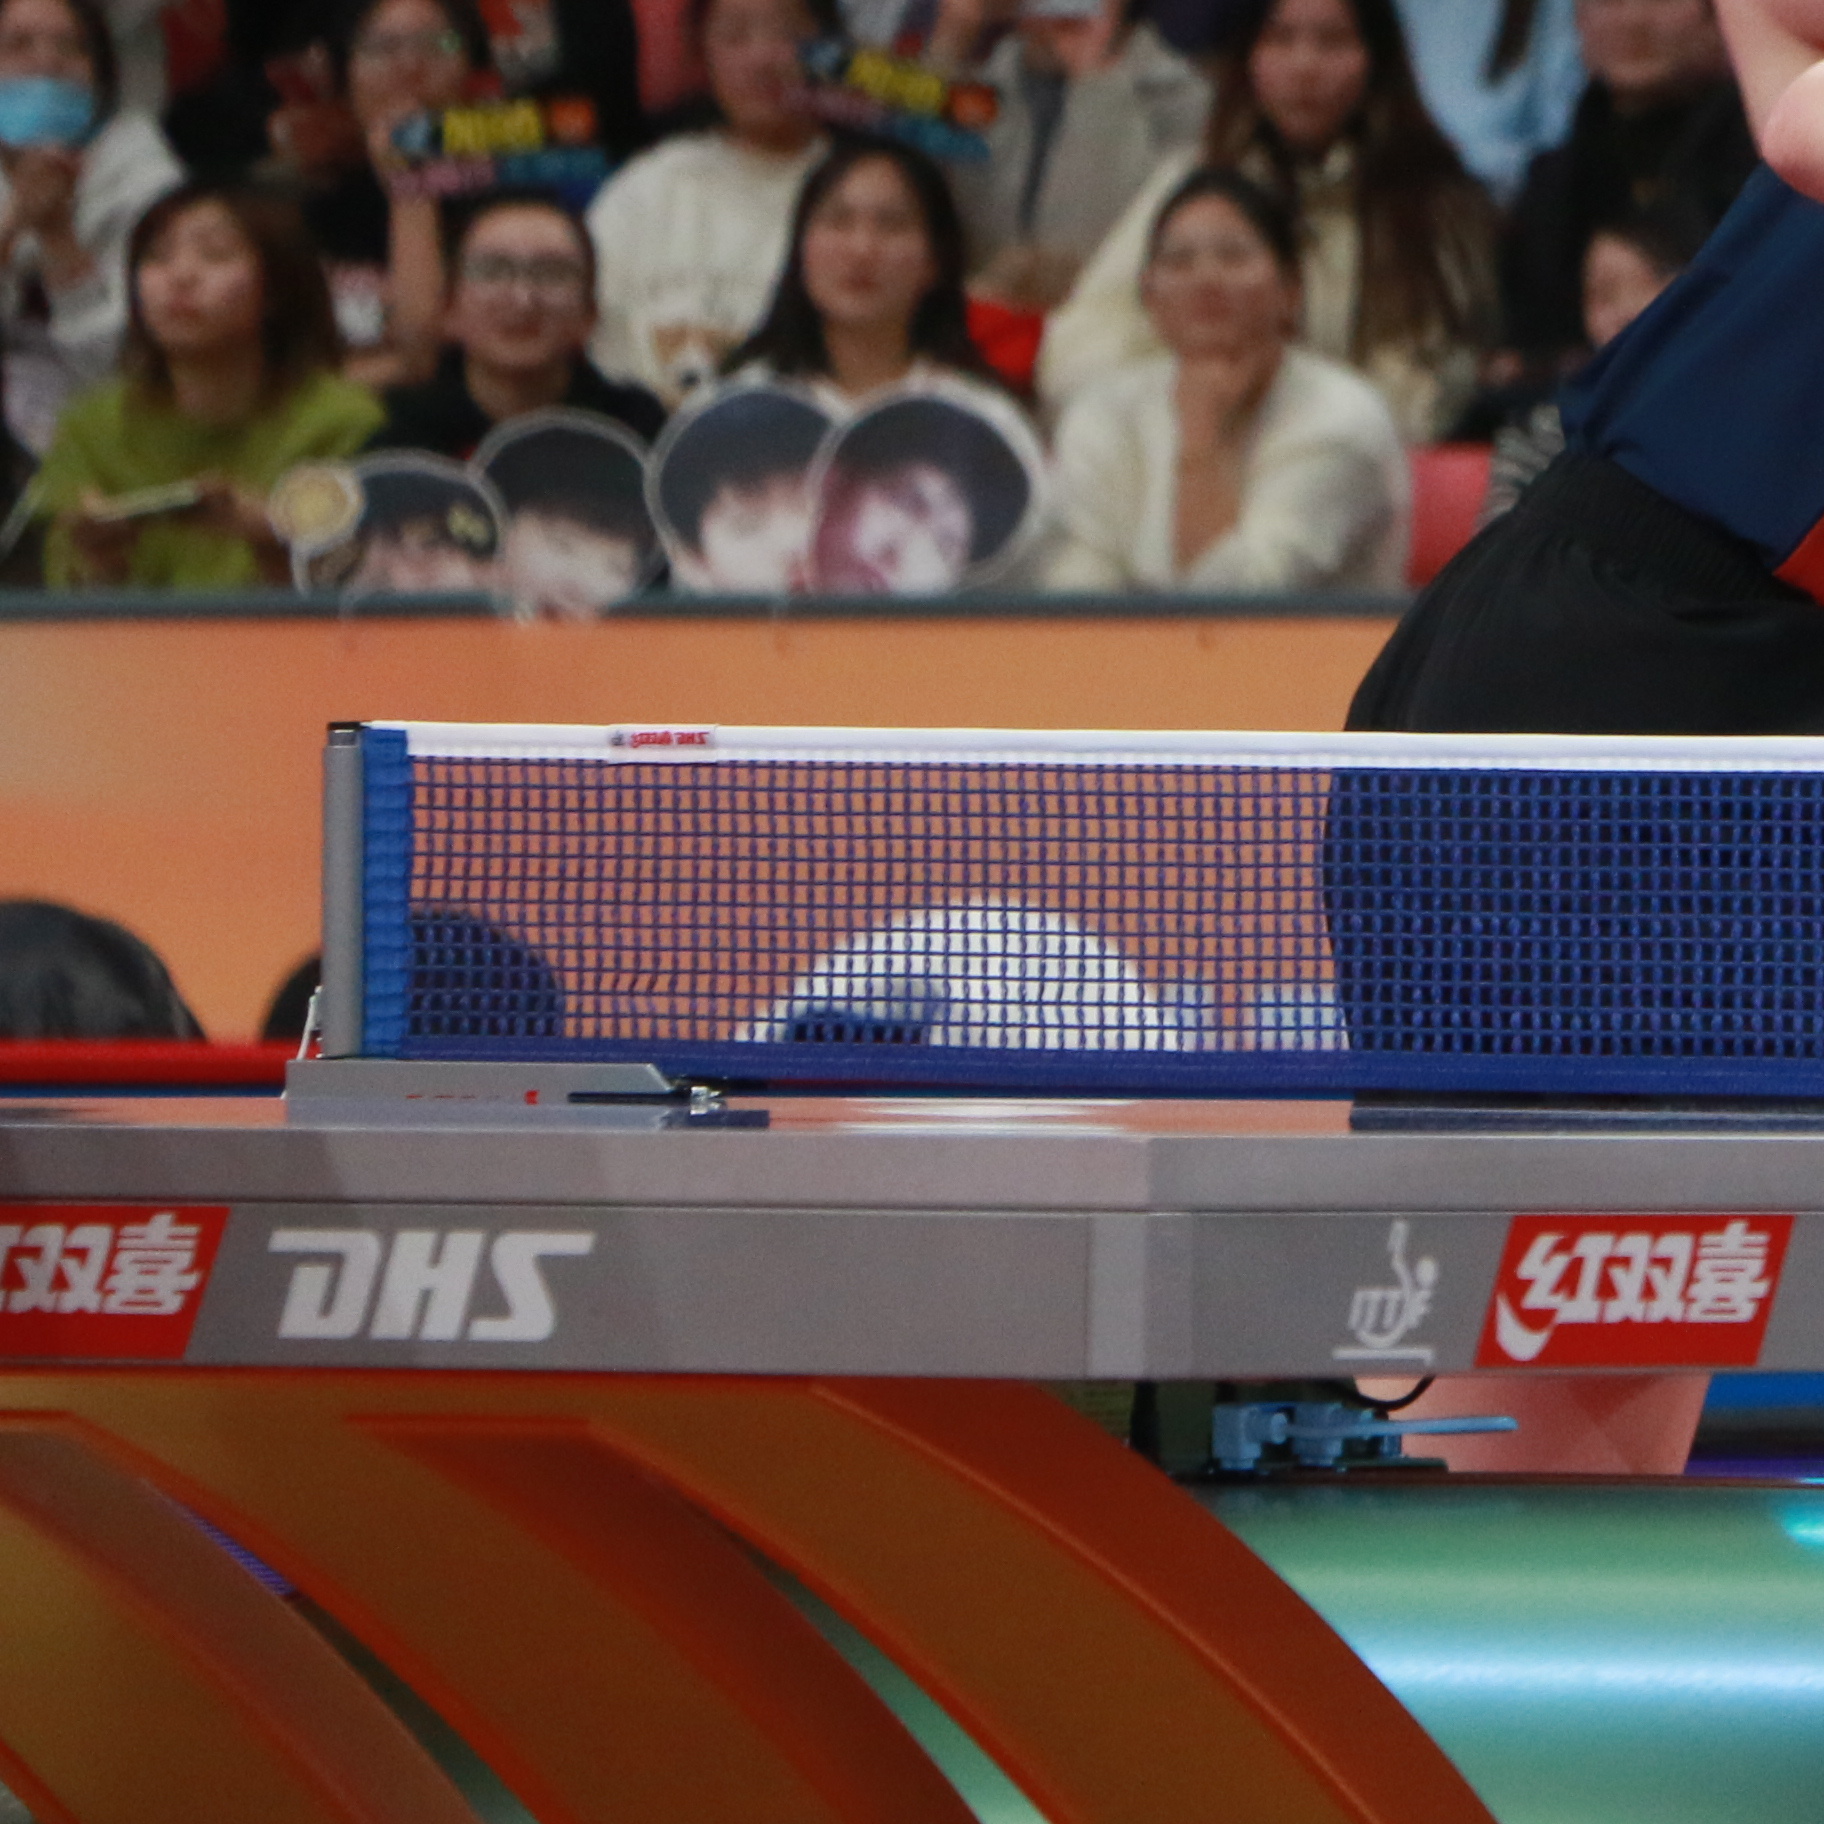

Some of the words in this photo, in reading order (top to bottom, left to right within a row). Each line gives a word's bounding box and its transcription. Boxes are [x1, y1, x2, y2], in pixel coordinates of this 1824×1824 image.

[0, 1212, 204, 1315] 双喜
[268, 1229, 596, 1341] DHS
[1515, 1219, 1772, 1324] 红双喜
